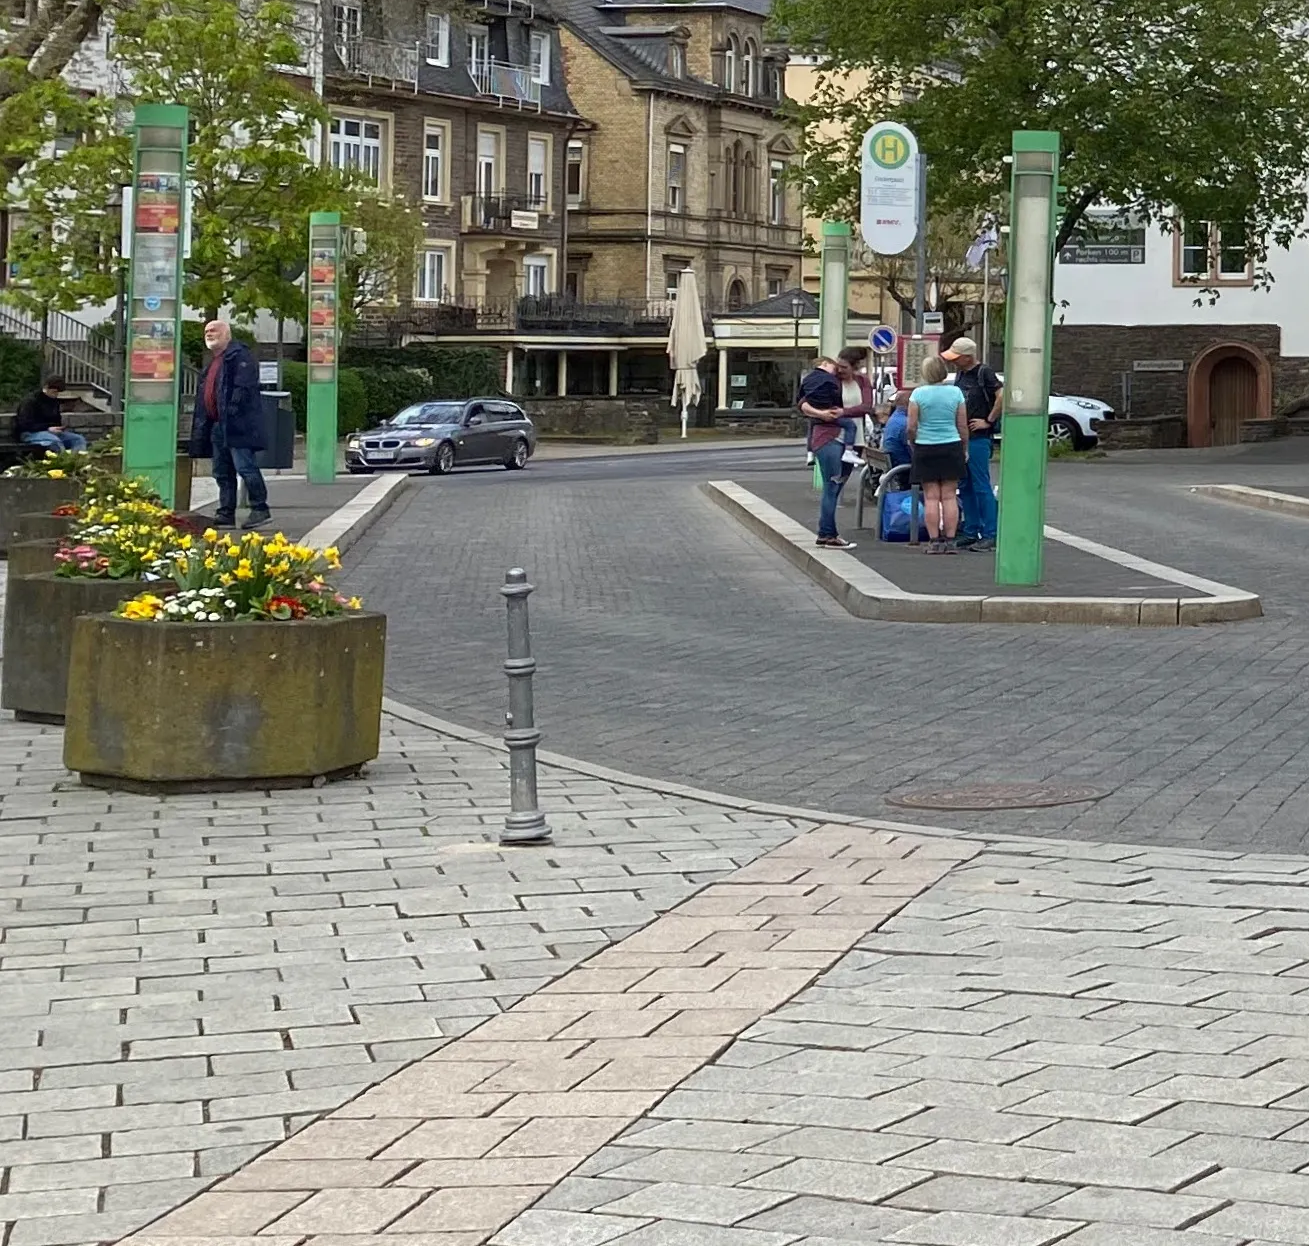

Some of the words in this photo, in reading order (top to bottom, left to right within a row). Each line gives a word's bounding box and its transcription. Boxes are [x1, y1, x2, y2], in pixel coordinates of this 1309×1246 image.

[882, 138, 897, 160] H
[1076, 248, 1102, 256] Parken
[1104, 248, 1119, 256] 100
